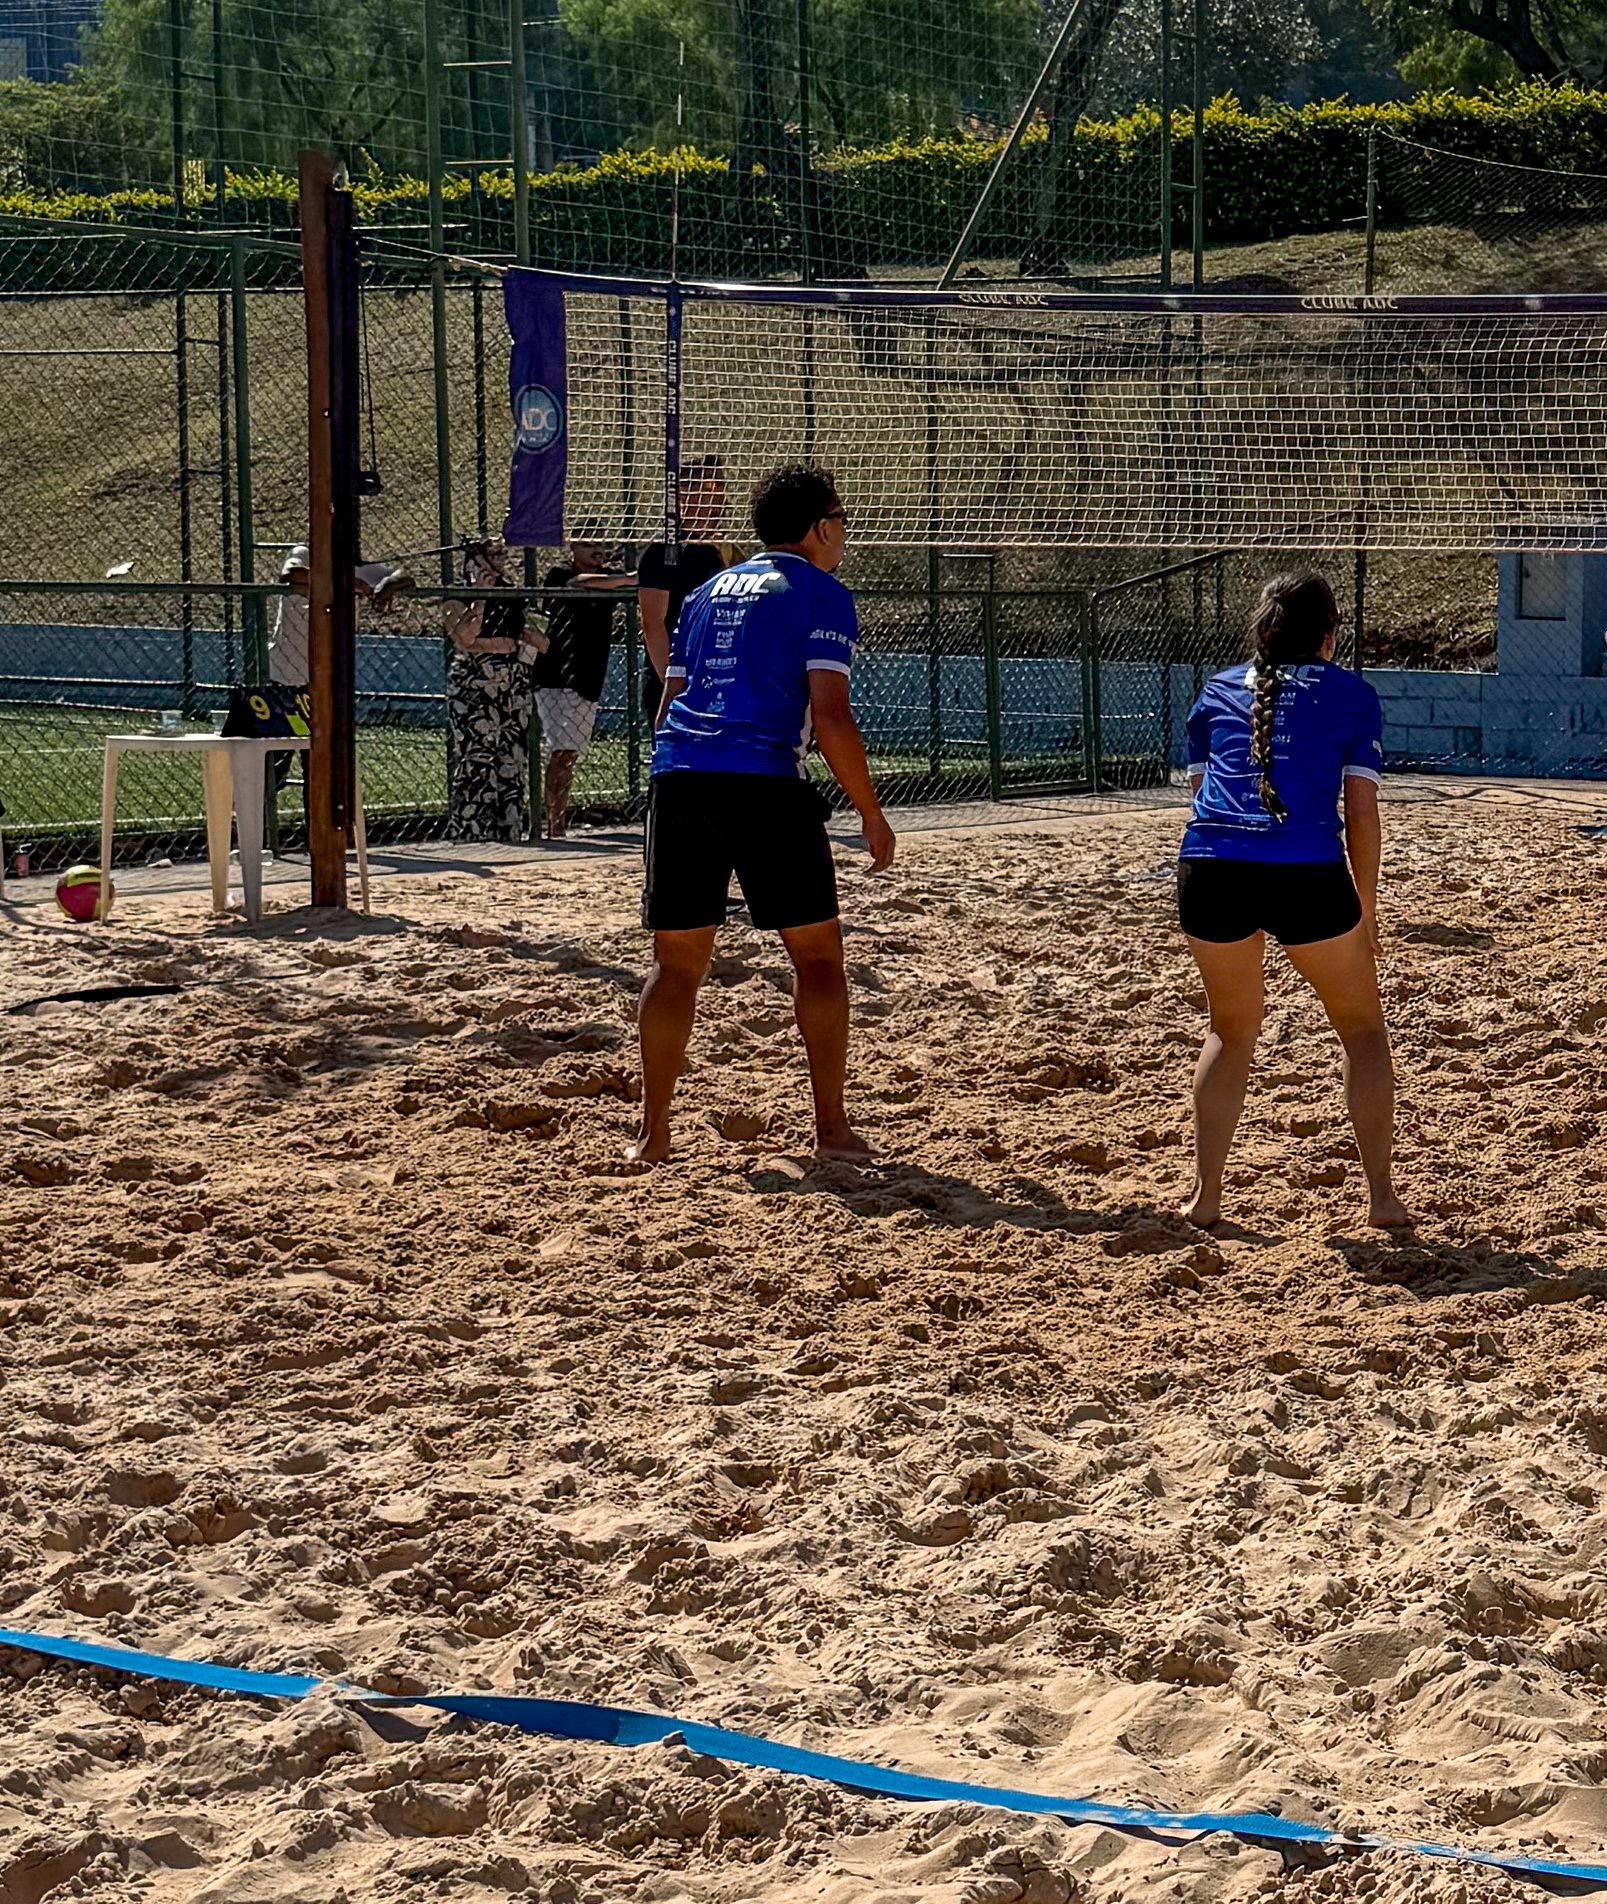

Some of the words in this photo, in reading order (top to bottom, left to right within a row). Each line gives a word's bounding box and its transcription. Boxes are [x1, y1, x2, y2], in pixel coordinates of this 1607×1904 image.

[668, 387, 677, 415] ADC
[710, 572, 782, 597] ADC
[249, 695, 271, 721] 9
